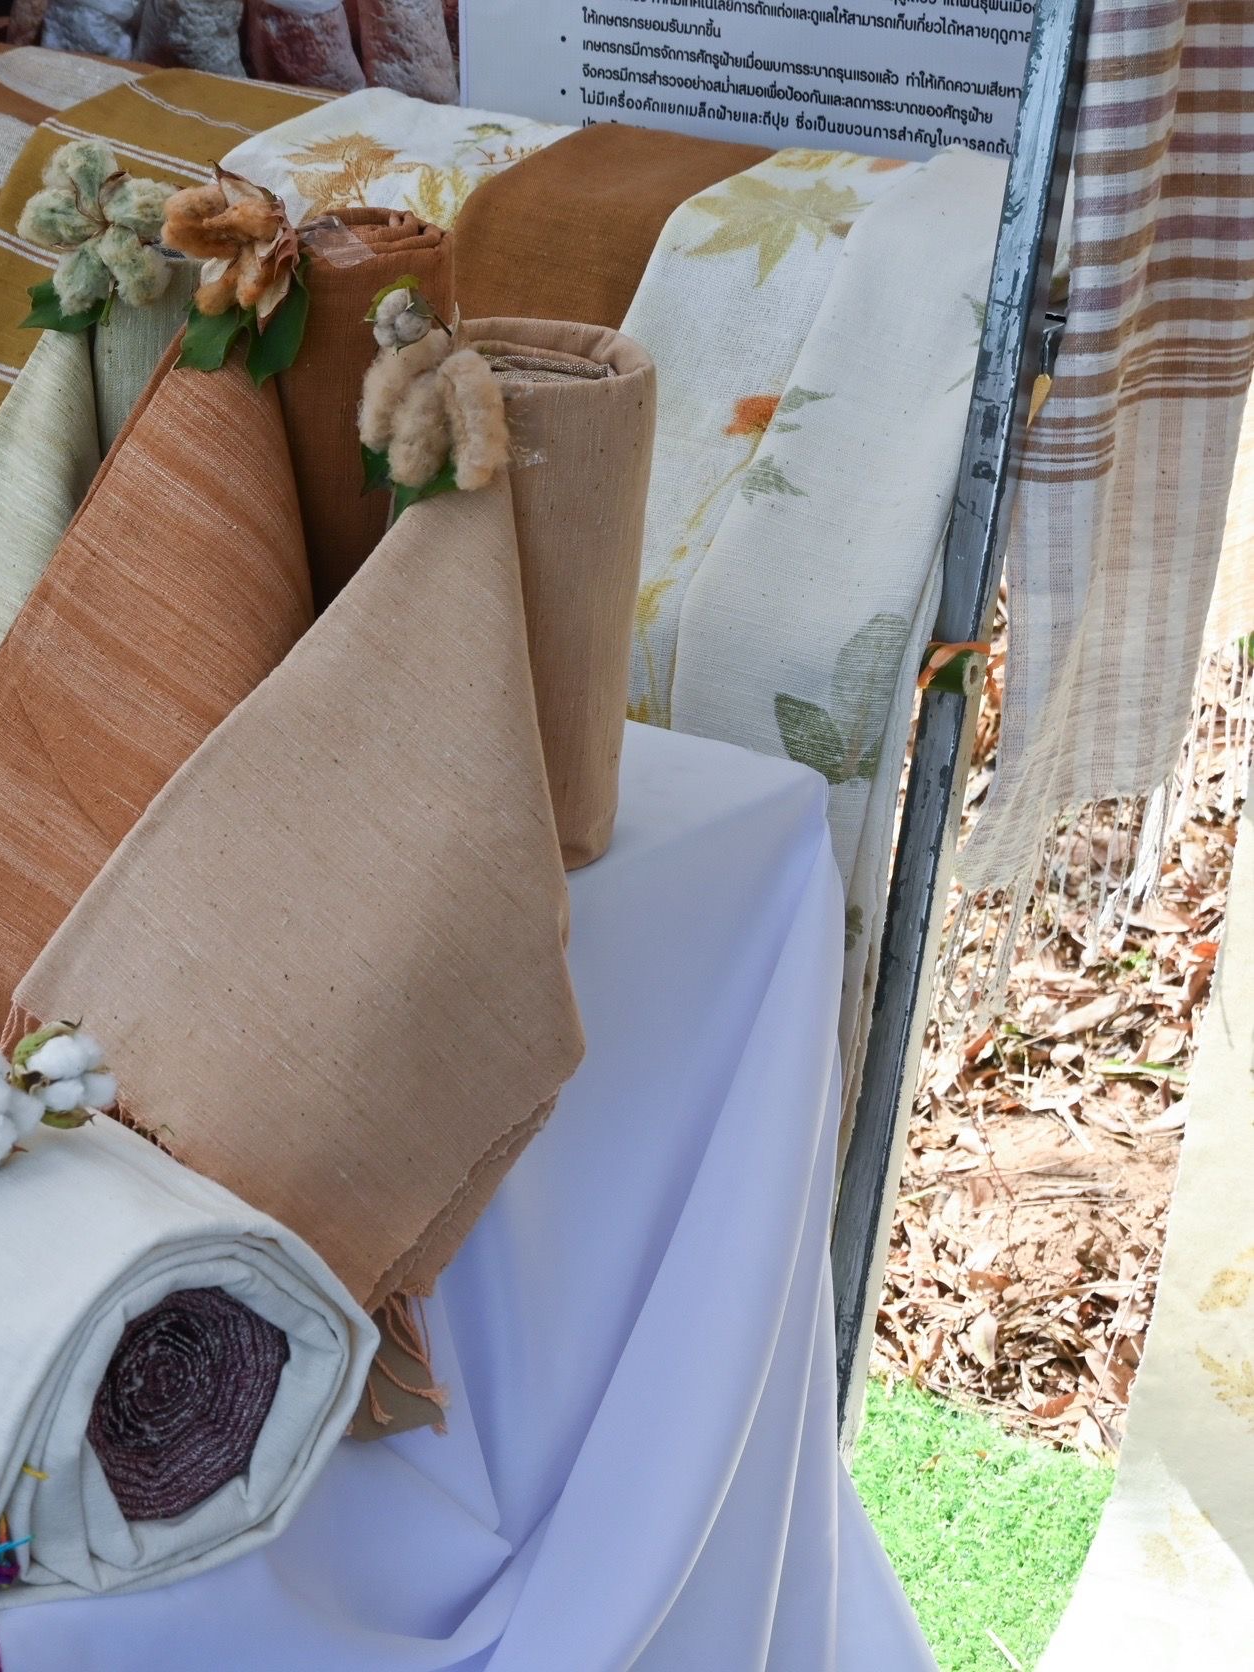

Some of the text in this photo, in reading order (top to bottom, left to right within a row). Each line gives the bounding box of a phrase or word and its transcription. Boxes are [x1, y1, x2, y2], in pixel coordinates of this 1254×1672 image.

[582, 6, 721, 38] ให้เกษตรกรยอมรับมากขึ้น
